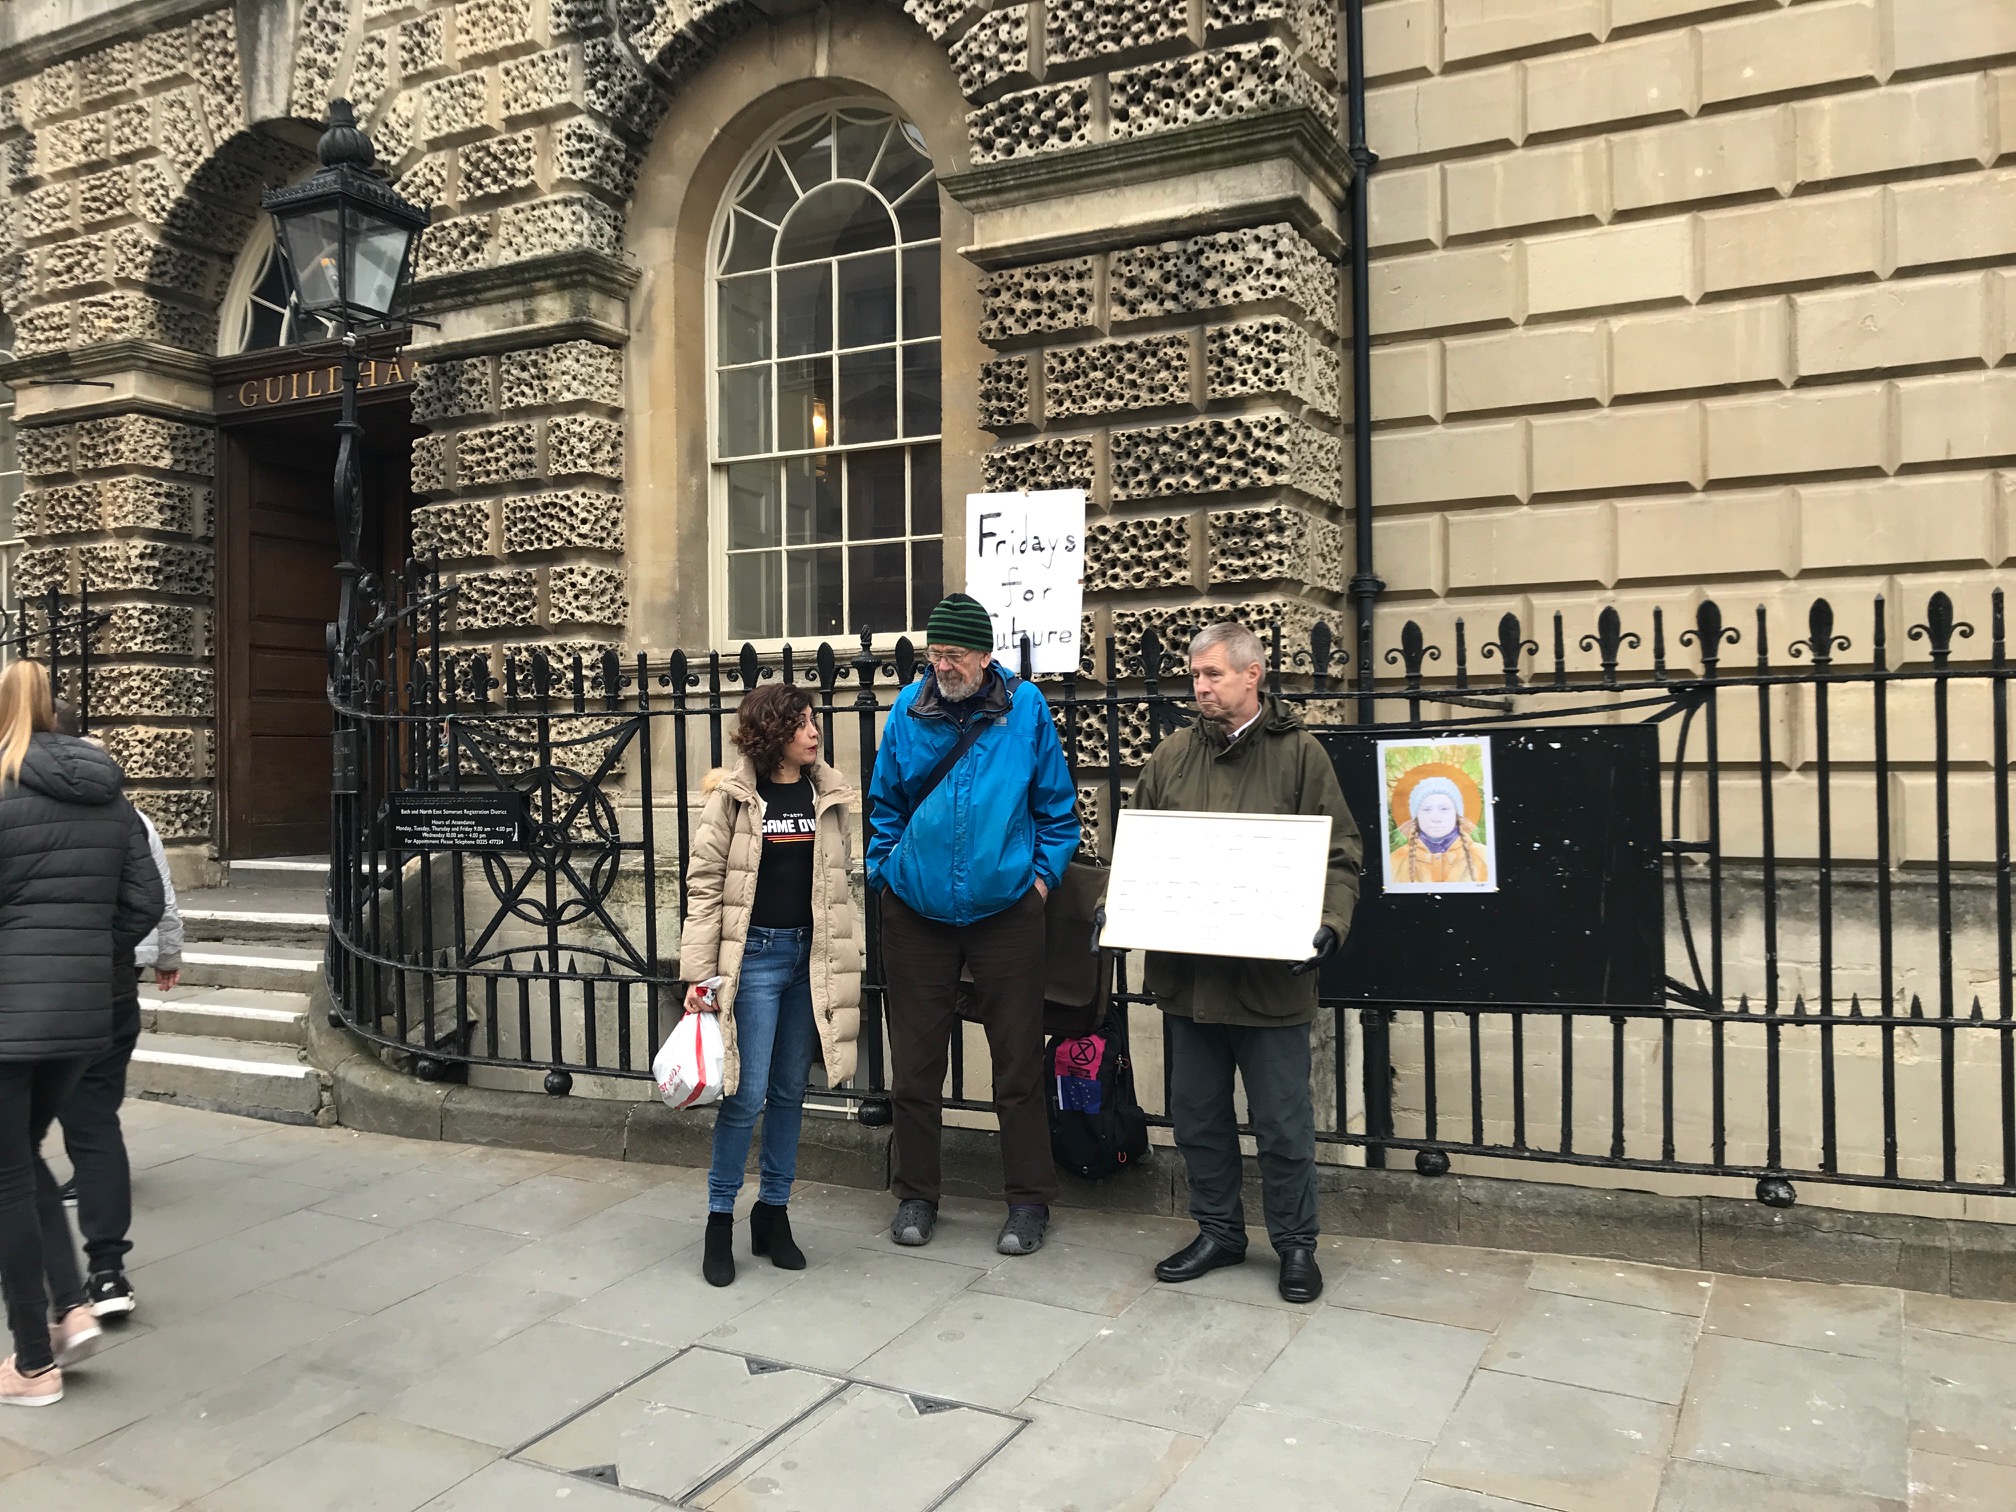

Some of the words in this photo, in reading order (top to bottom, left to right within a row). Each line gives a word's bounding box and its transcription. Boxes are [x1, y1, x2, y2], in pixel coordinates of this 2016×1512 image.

[239, 360, 419, 407] GUILDHA
[979, 512, 1076, 569] Fridays
[1001, 567, 1052, 607] for
[989, 613, 1072, 651] uture
[762, 819, 796, 833] GAME
